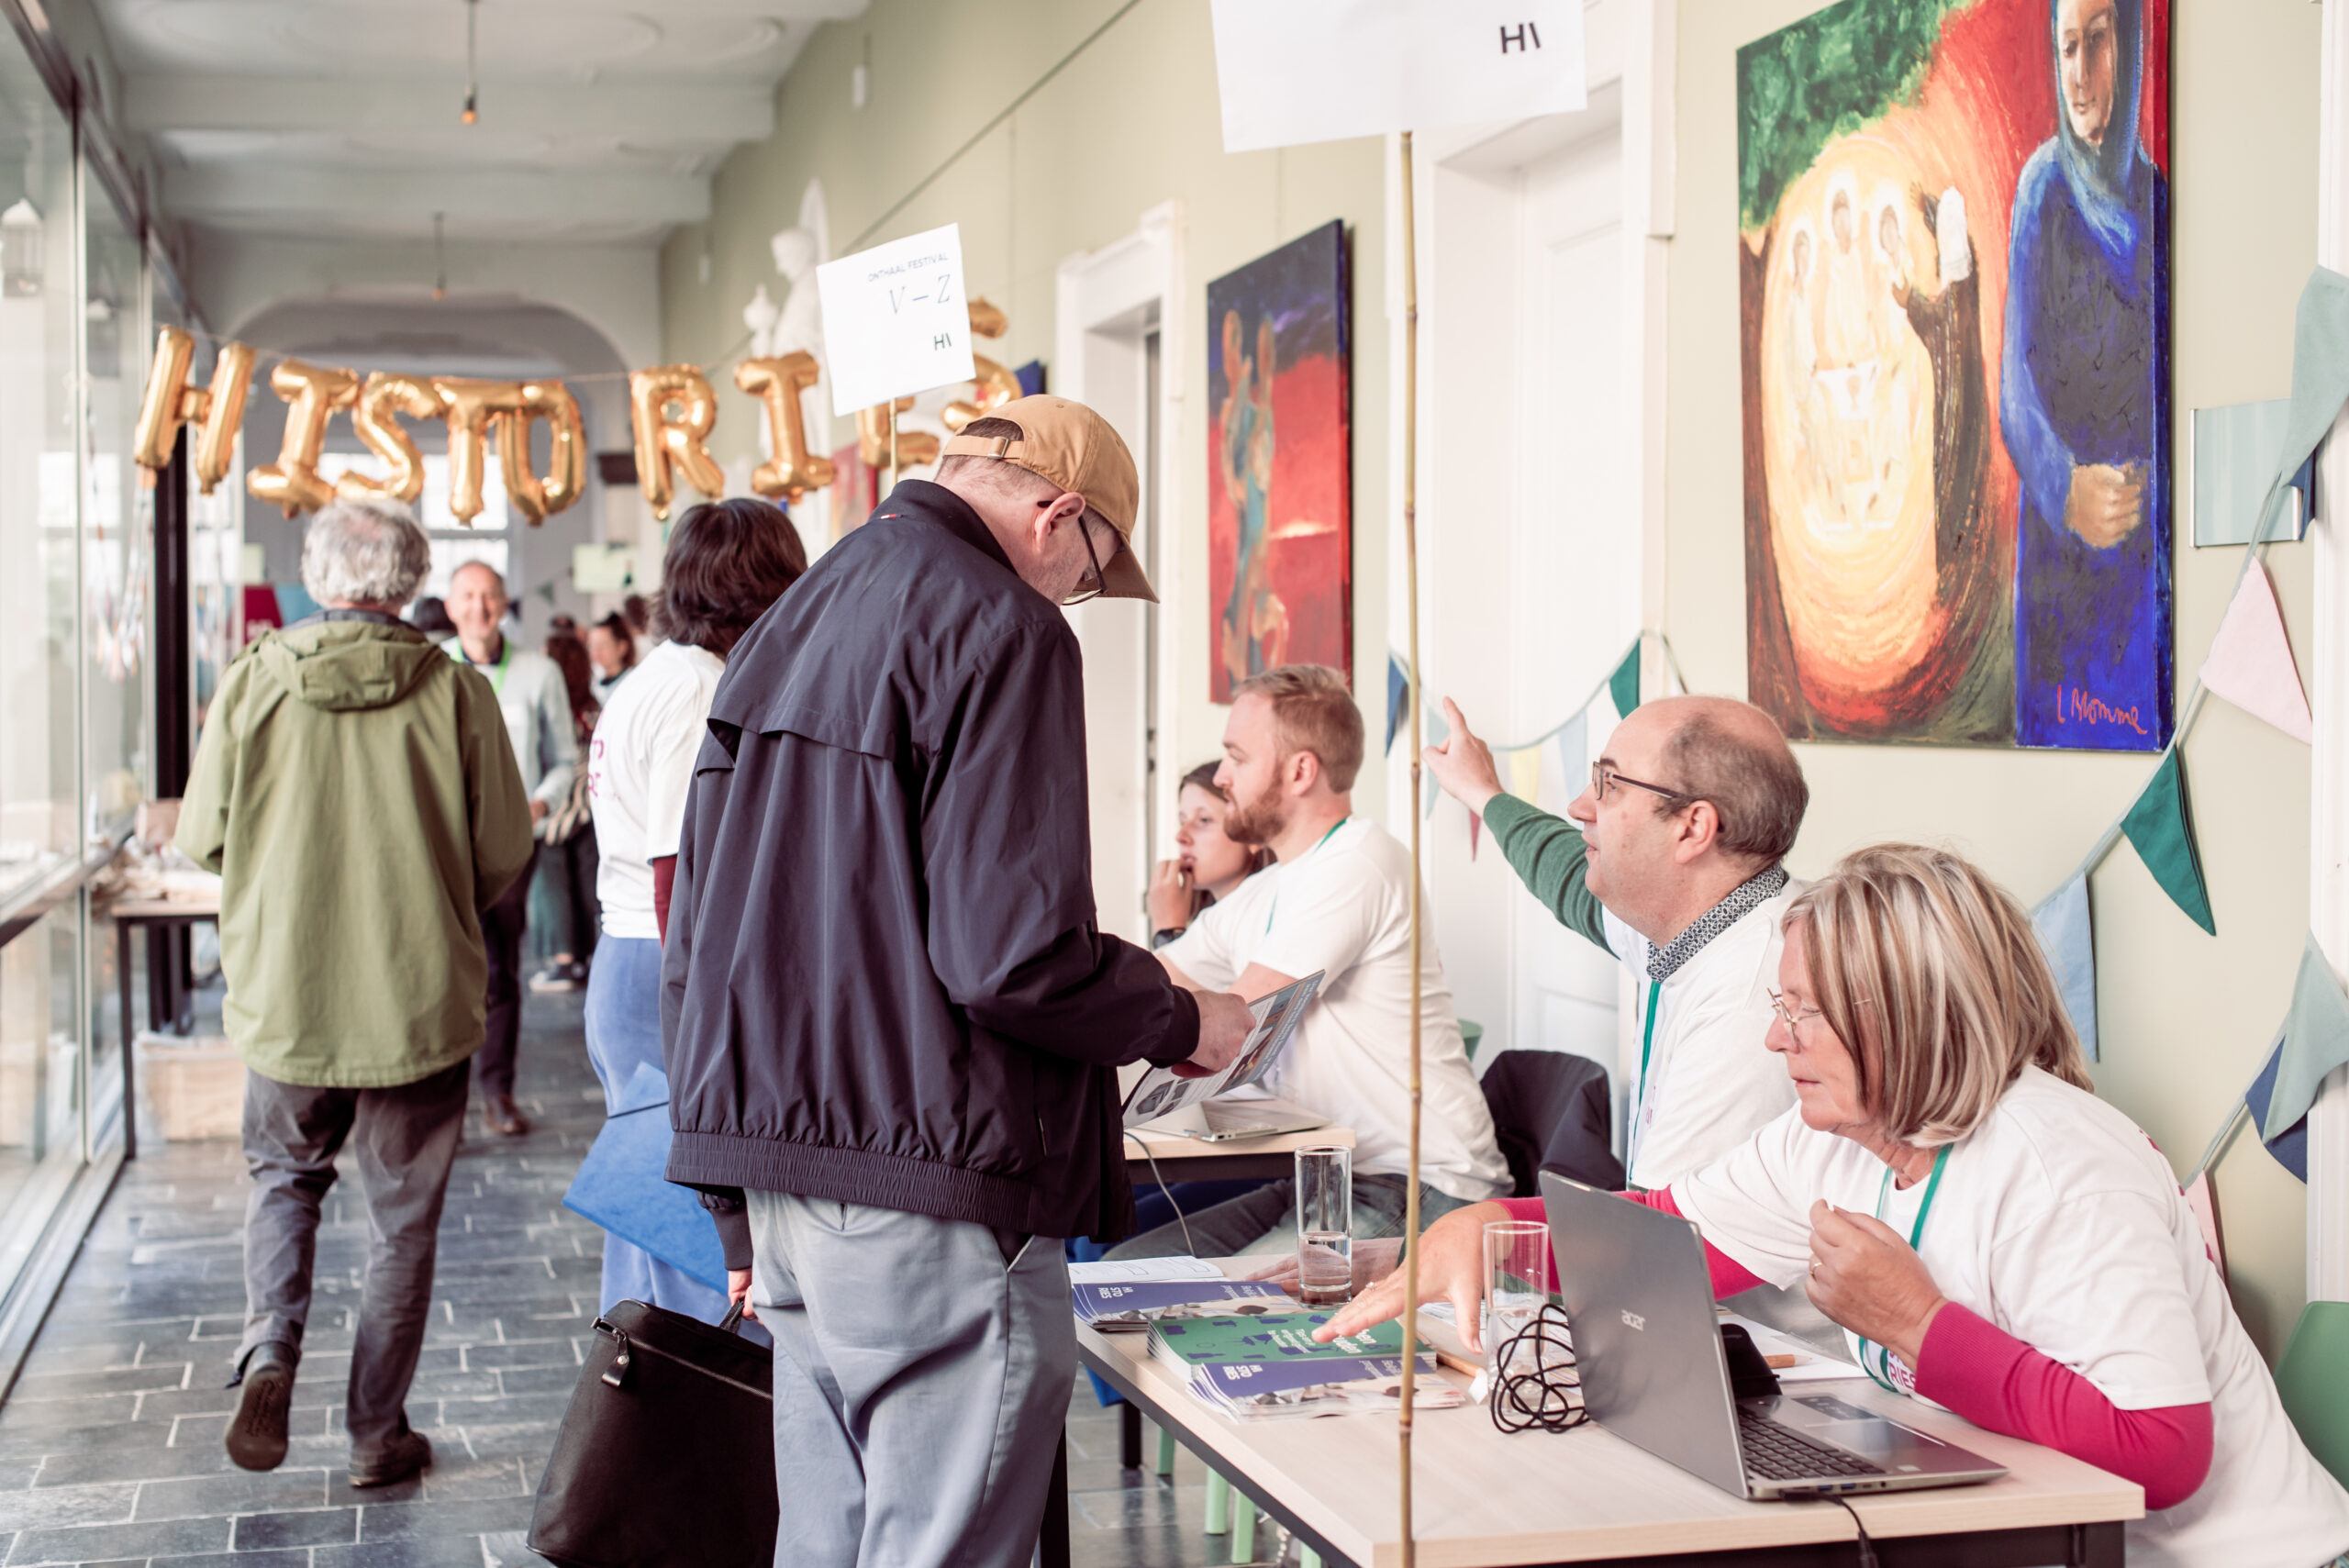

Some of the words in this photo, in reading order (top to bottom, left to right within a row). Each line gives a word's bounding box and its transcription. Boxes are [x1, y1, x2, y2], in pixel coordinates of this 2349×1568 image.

[867, 264, 906, 283] ONTHAAL
[907, 252, 950, 270] FESTIVAL
[888, 285, 906, 316] V
[937, 272, 952, 305] Z
[1620, 1308, 1647, 1333] acer
